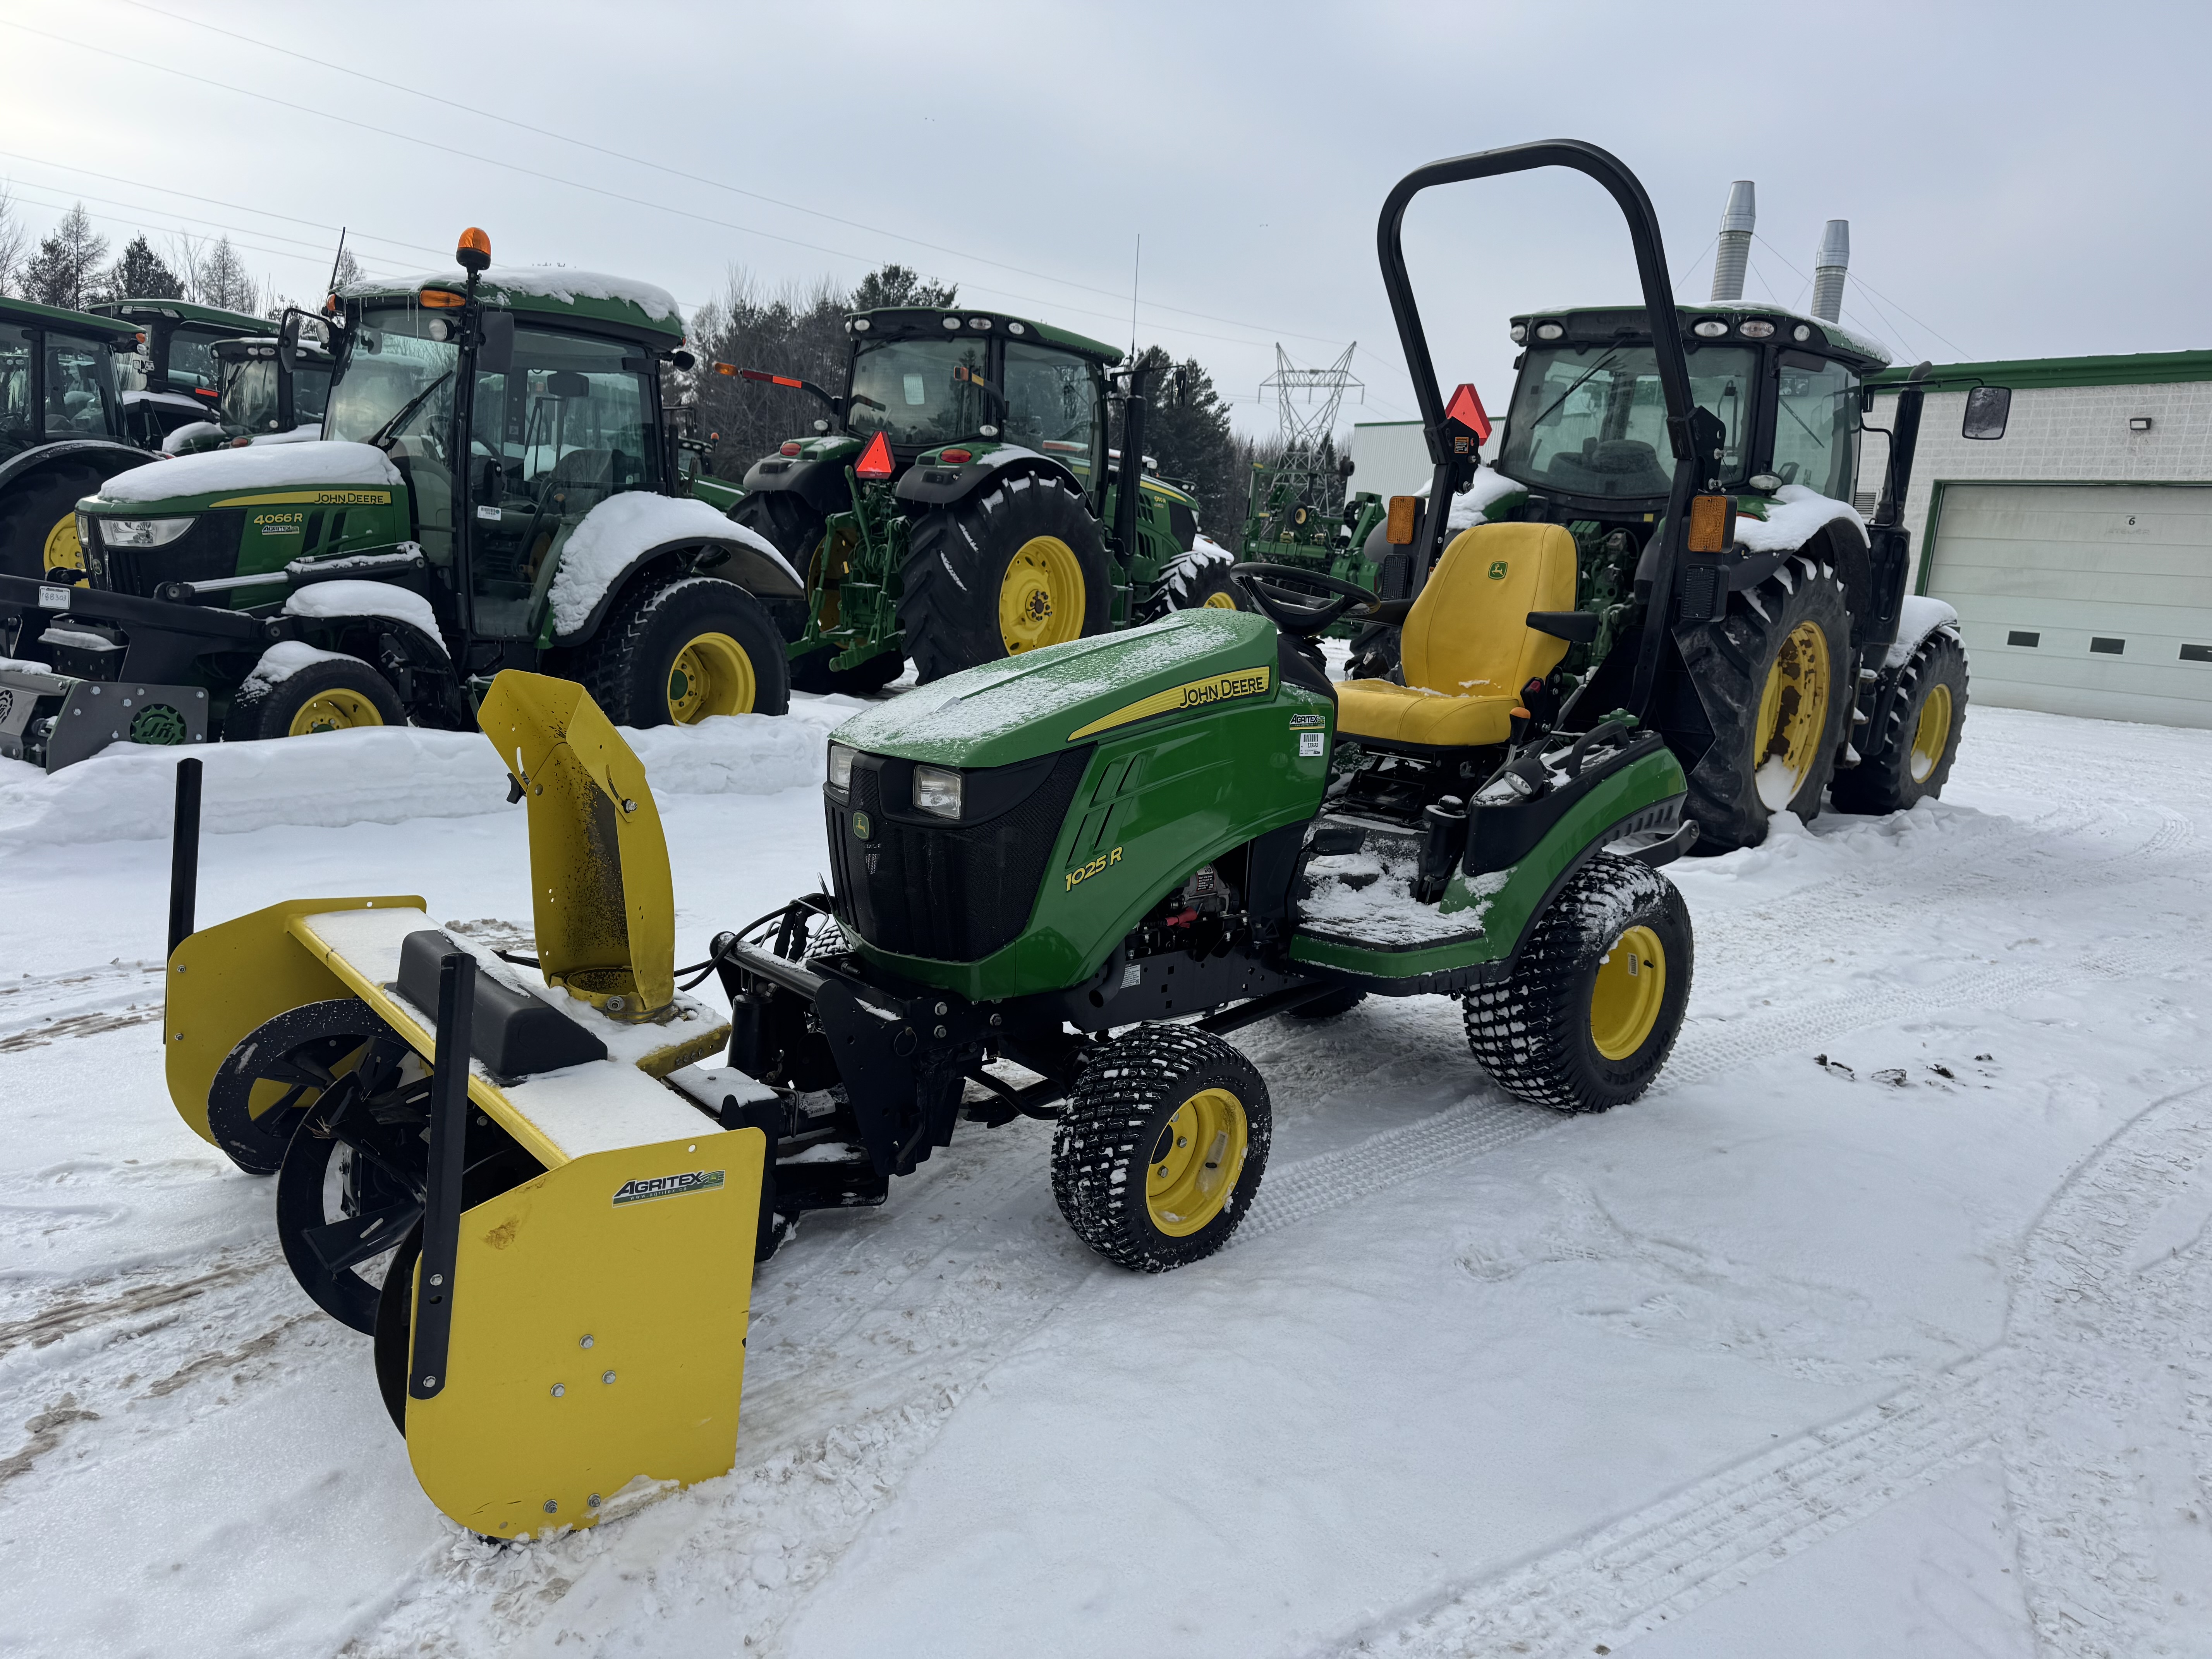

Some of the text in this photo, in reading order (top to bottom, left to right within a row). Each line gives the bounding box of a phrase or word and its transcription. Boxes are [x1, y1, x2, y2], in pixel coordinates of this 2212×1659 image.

[314, 493, 383, 503] JOHN DEERE
[254, 513, 303, 525] 4066 R
[2129, 517, 2135, 525] 6
[1180, 677, 1264, 707] JOHN DEERE
[1291, 714, 1318, 723] AGRITEX
[1065, 847, 1123, 891] 1025 R
[613, 1171, 703, 1197] AGRITEX
[630, 1187, 687, 1200] www.agritex.ca
